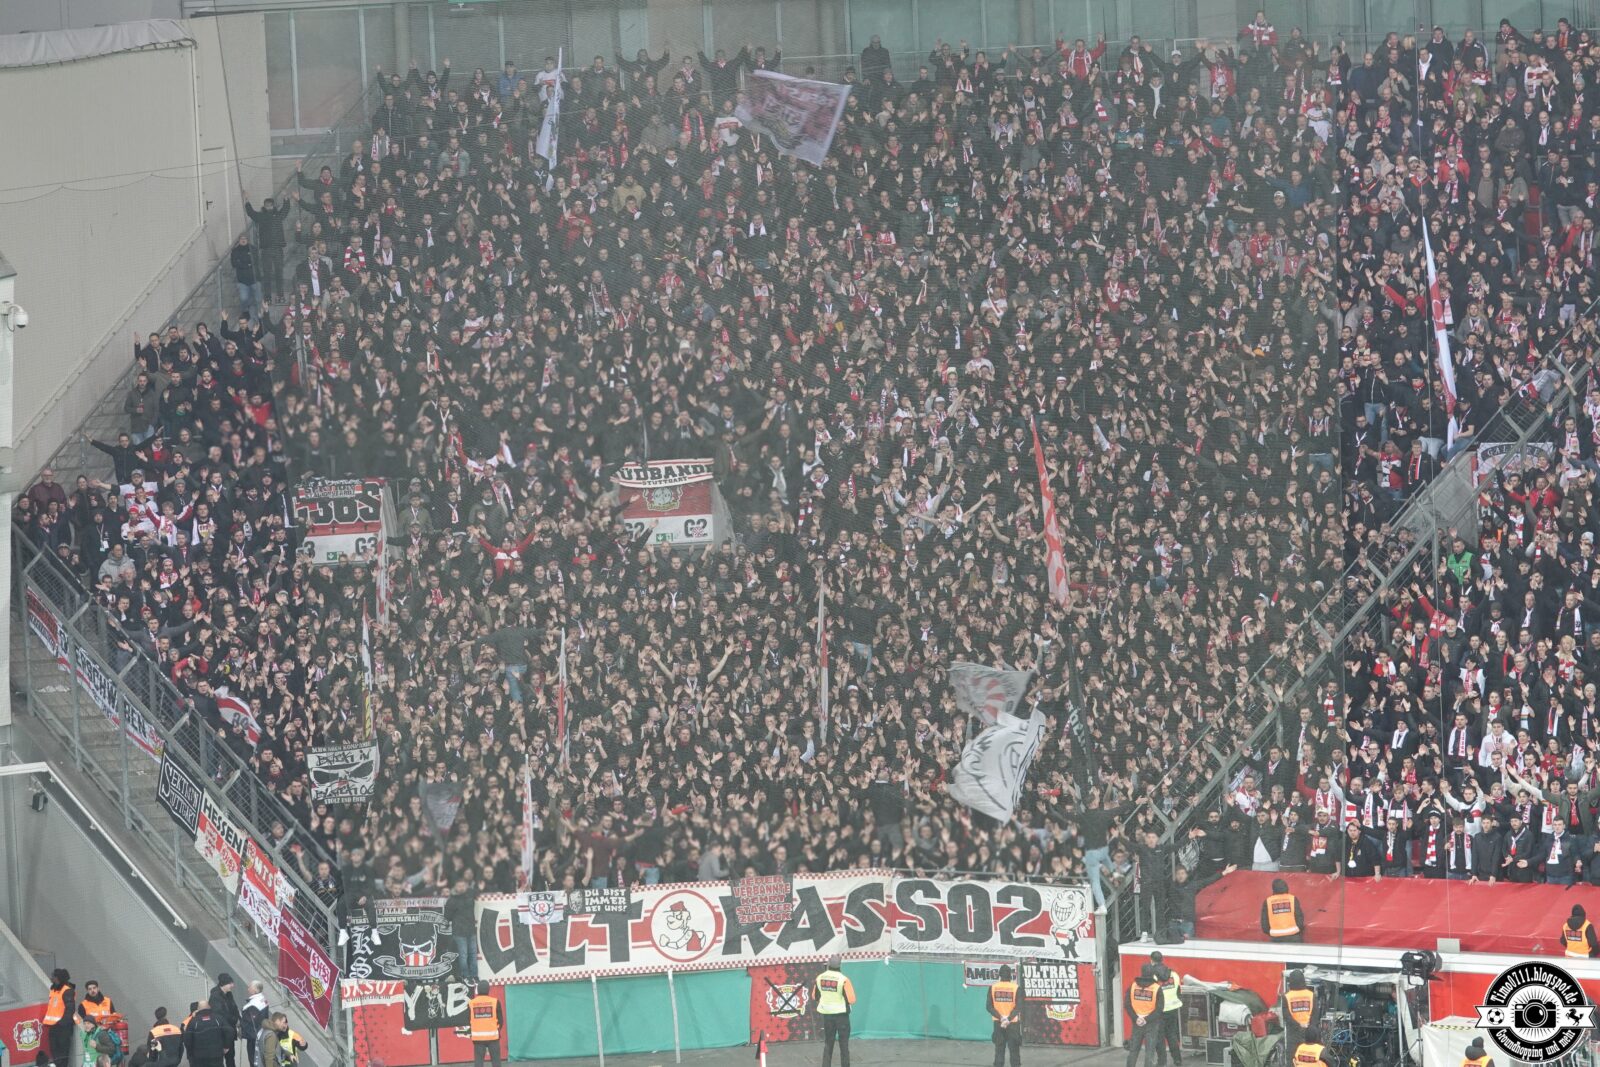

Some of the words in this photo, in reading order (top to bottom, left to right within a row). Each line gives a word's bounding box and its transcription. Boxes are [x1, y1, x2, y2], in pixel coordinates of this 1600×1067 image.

[684, 518, 708, 538] G2
[203, 797, 243, 855] HESSEN
[740, 875, 784, 886] JEDER
[585, 889, 600, 897] DU
[603, 888, 627, 897] BIST
[733, 883, 791, 897] VERBANNTE
[530, 893, 553, 901] SSV
[585, 896, 627, 905] IMMER
[1023, 965, 1077, 979] ULTRAS
[1024, 978, 1078, 989] BEDEUTET
[1024, 988, 1080, 998] WIDERSTAND
